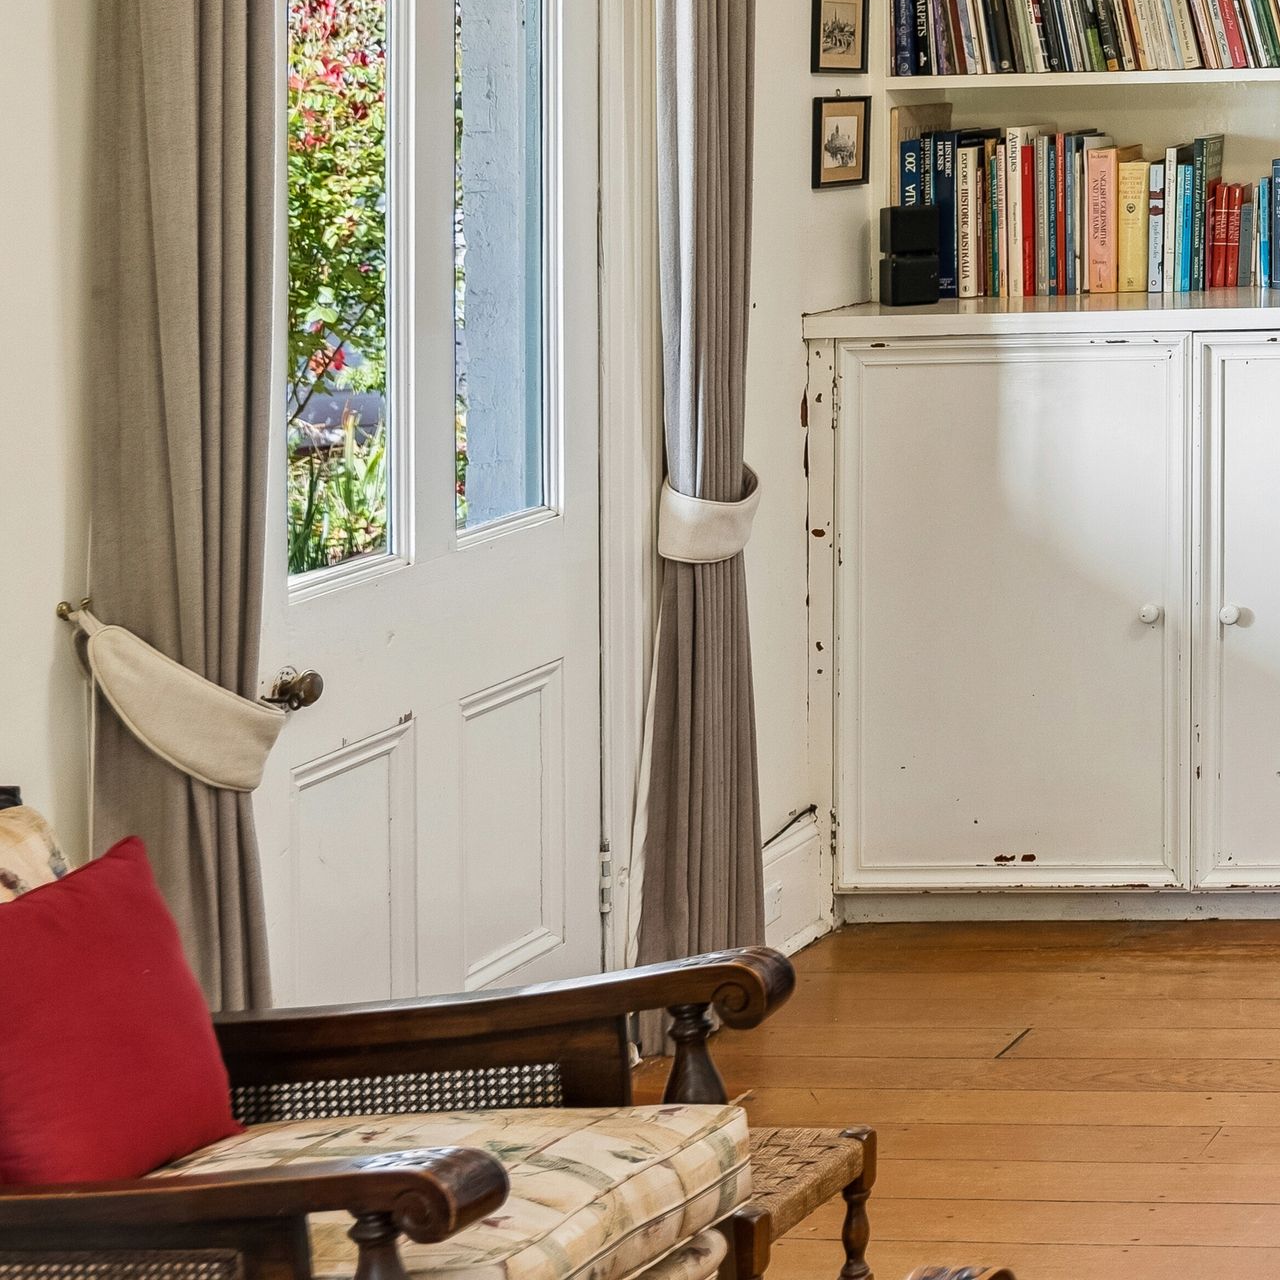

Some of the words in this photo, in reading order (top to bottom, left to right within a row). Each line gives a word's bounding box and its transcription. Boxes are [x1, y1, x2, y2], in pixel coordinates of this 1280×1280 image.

[1008, 132, 1019, 172] Antiques
[961, 188, 969, 229] HISTORIC
[961, 231, 970, 280] AUSTRALIA
